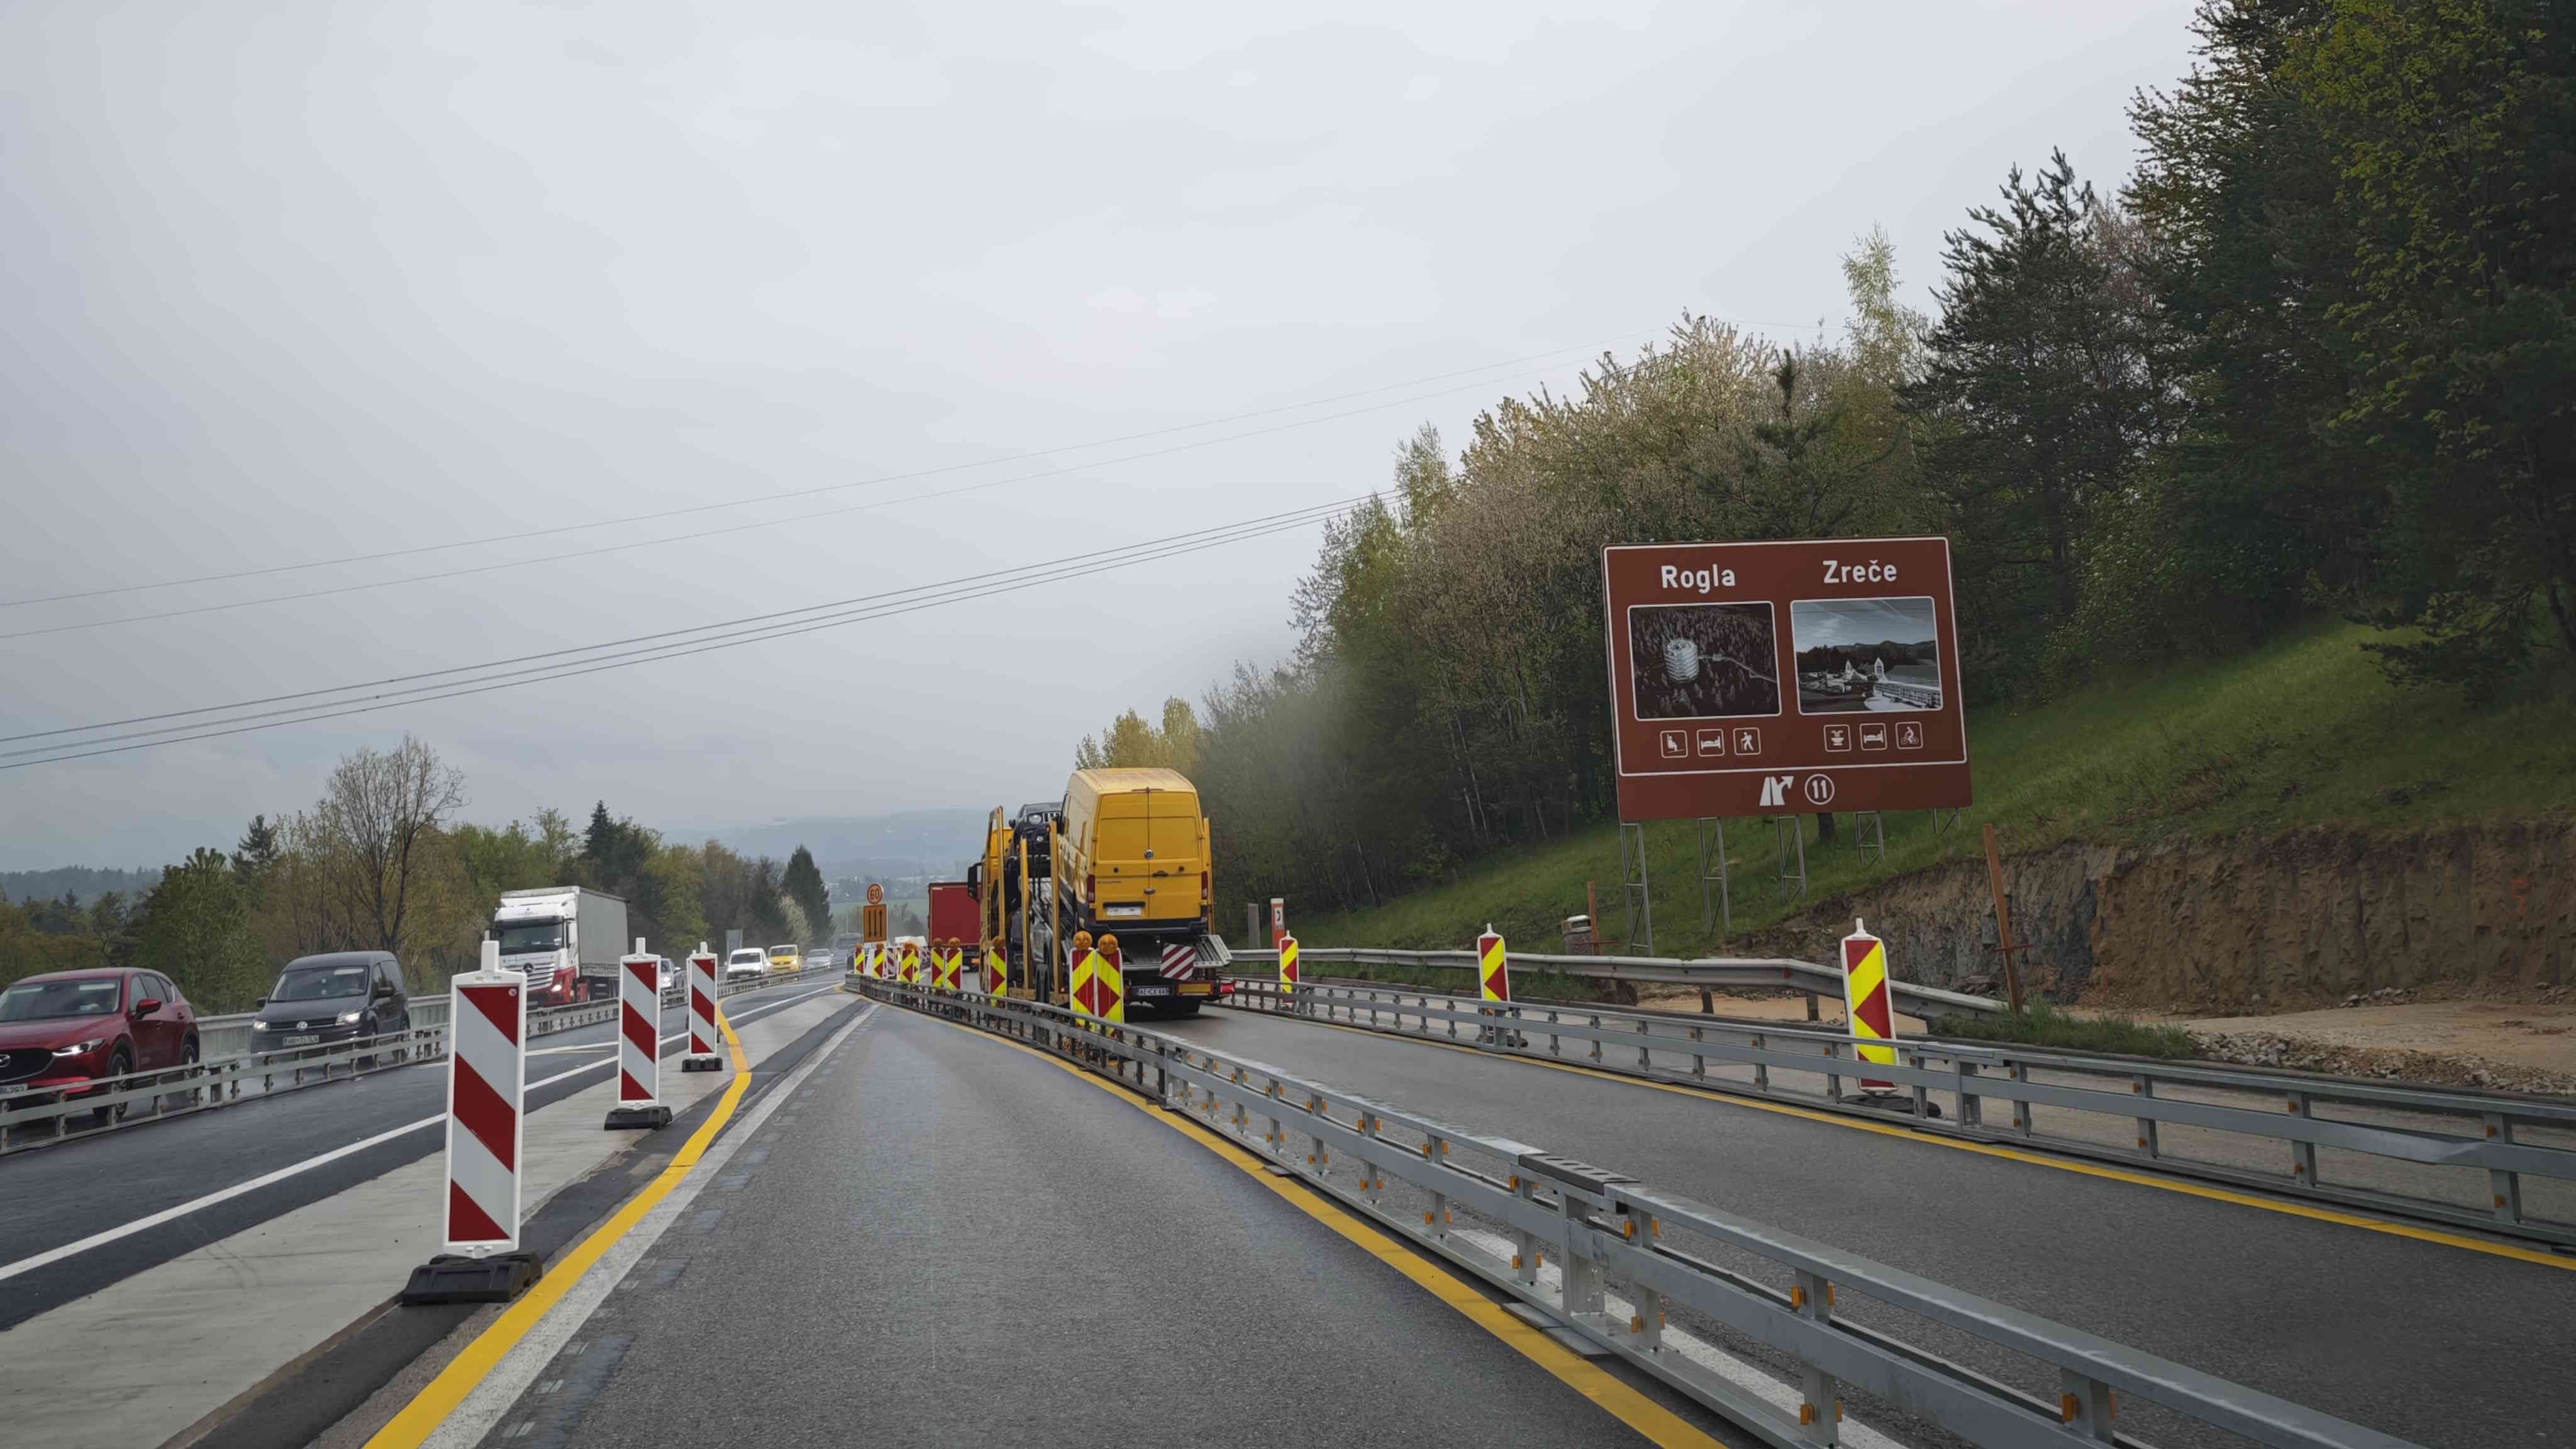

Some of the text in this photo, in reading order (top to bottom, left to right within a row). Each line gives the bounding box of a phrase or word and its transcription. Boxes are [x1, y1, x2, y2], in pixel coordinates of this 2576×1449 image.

[1661, 564, 1736, 593] Rogla
[1823, 560, 1897, 583] Zreče
[1812, 780, 1827, 799] 11
[870, 888, 880, 899] 60
